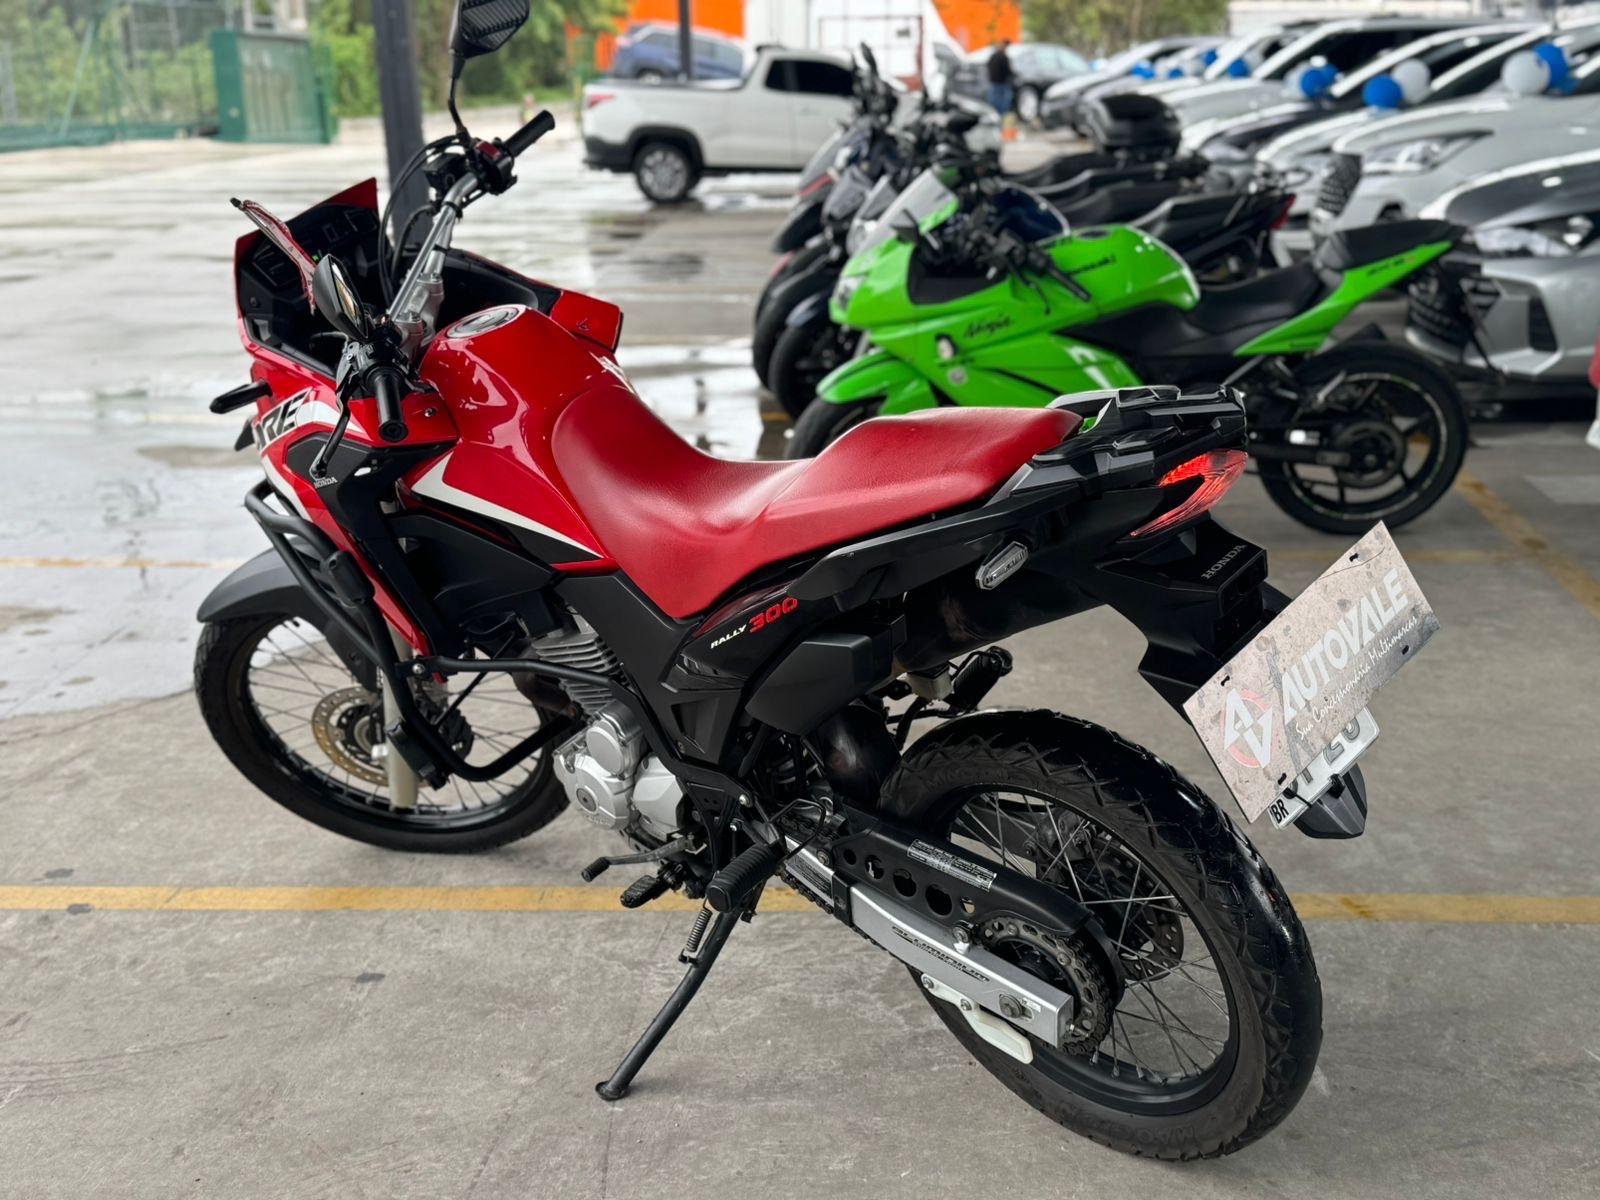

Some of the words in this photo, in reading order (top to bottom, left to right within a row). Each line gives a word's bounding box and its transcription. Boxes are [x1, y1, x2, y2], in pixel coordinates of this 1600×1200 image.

[1200, 544, 1247, 580] HONDA
[710, 624, 747, 649] RALLY
[748, 596, 798, 634] 300
[1281, 567, 1409, 726] AUTOVALE
[1294, 719, 1314, 740] Sua
[1368, 615, 1418, 667] Multimarcas
[1270, 798, 1290, 824] BR
